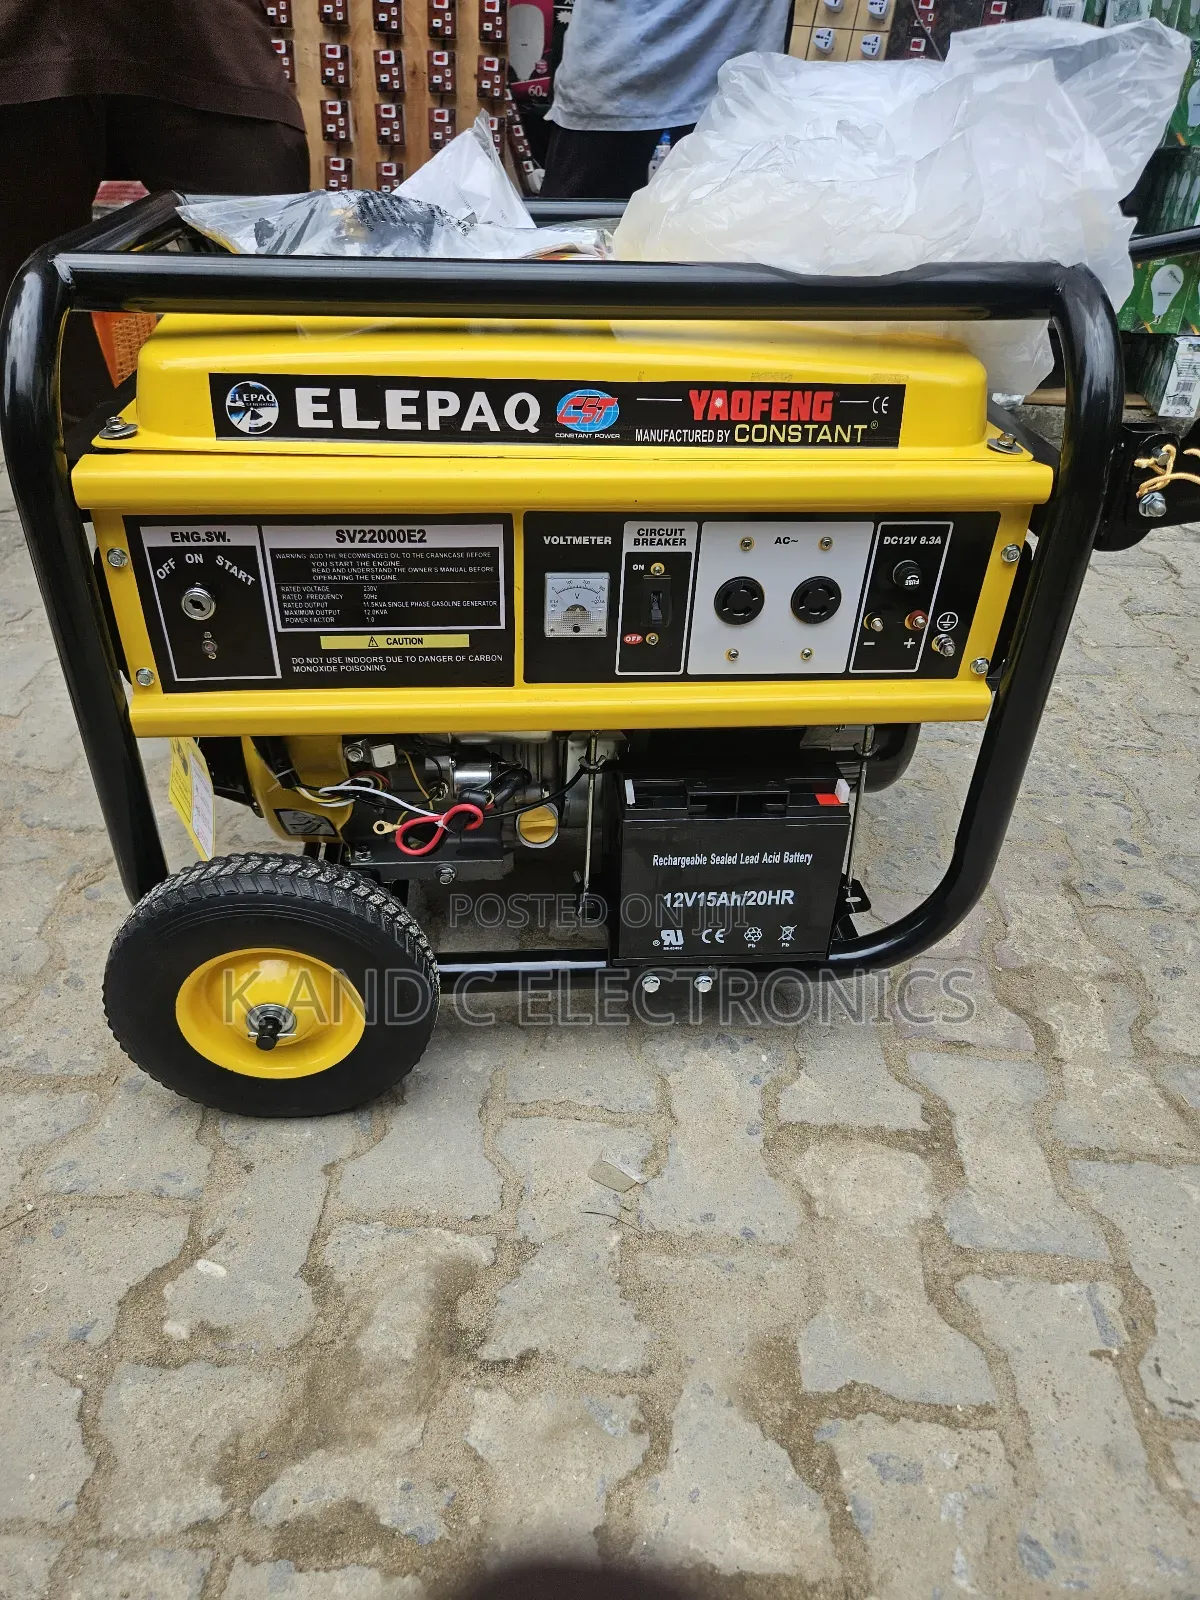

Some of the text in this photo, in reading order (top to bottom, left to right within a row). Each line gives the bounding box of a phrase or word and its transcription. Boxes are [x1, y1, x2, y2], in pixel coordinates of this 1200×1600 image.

[230, 393, 276, 402] ELEPAQ
[294, 387, 541, 434] ELEPAQ
[556, 395, 619, 424] CST
[689, 389, 834, 422] YAOFENG
[635, 423, 868, 443] MANUFACTURED BY CONSTANT
[170, 531, 231, 543] ENG.SW.
[335, 529, 427, 544] SV22000E2
[636, 528, 686, 537] CIRCUIT
[543, 535, 612, 545] VOLTMETER
[633, 537, 687, 547] BREAKER
[883, 536, 942, 545] DC12V 8.3A
[185, 553, 204, 564] ON
[425, 551, 465, 559] CRANKCASE
[156, 557, 178, 580] OFF
[215, 554, 256, 586] START
[632, 563, 645, 571] ON
[386, 637, 424, 646] CAUTION
[625, 635, 643, 643] OFF
[292, 657, 305, 665] DO
[418, 655, 453, 663] DANGER
[468, 654, 503, 662] CARBON
[293, 664, 387, 673] MONOXIDE POISONING
[652, 851, 813, 869] Rechargeable Sealed Lead Acid Battery
[663, 889, 795, 908] 12V15Ah/20HR
